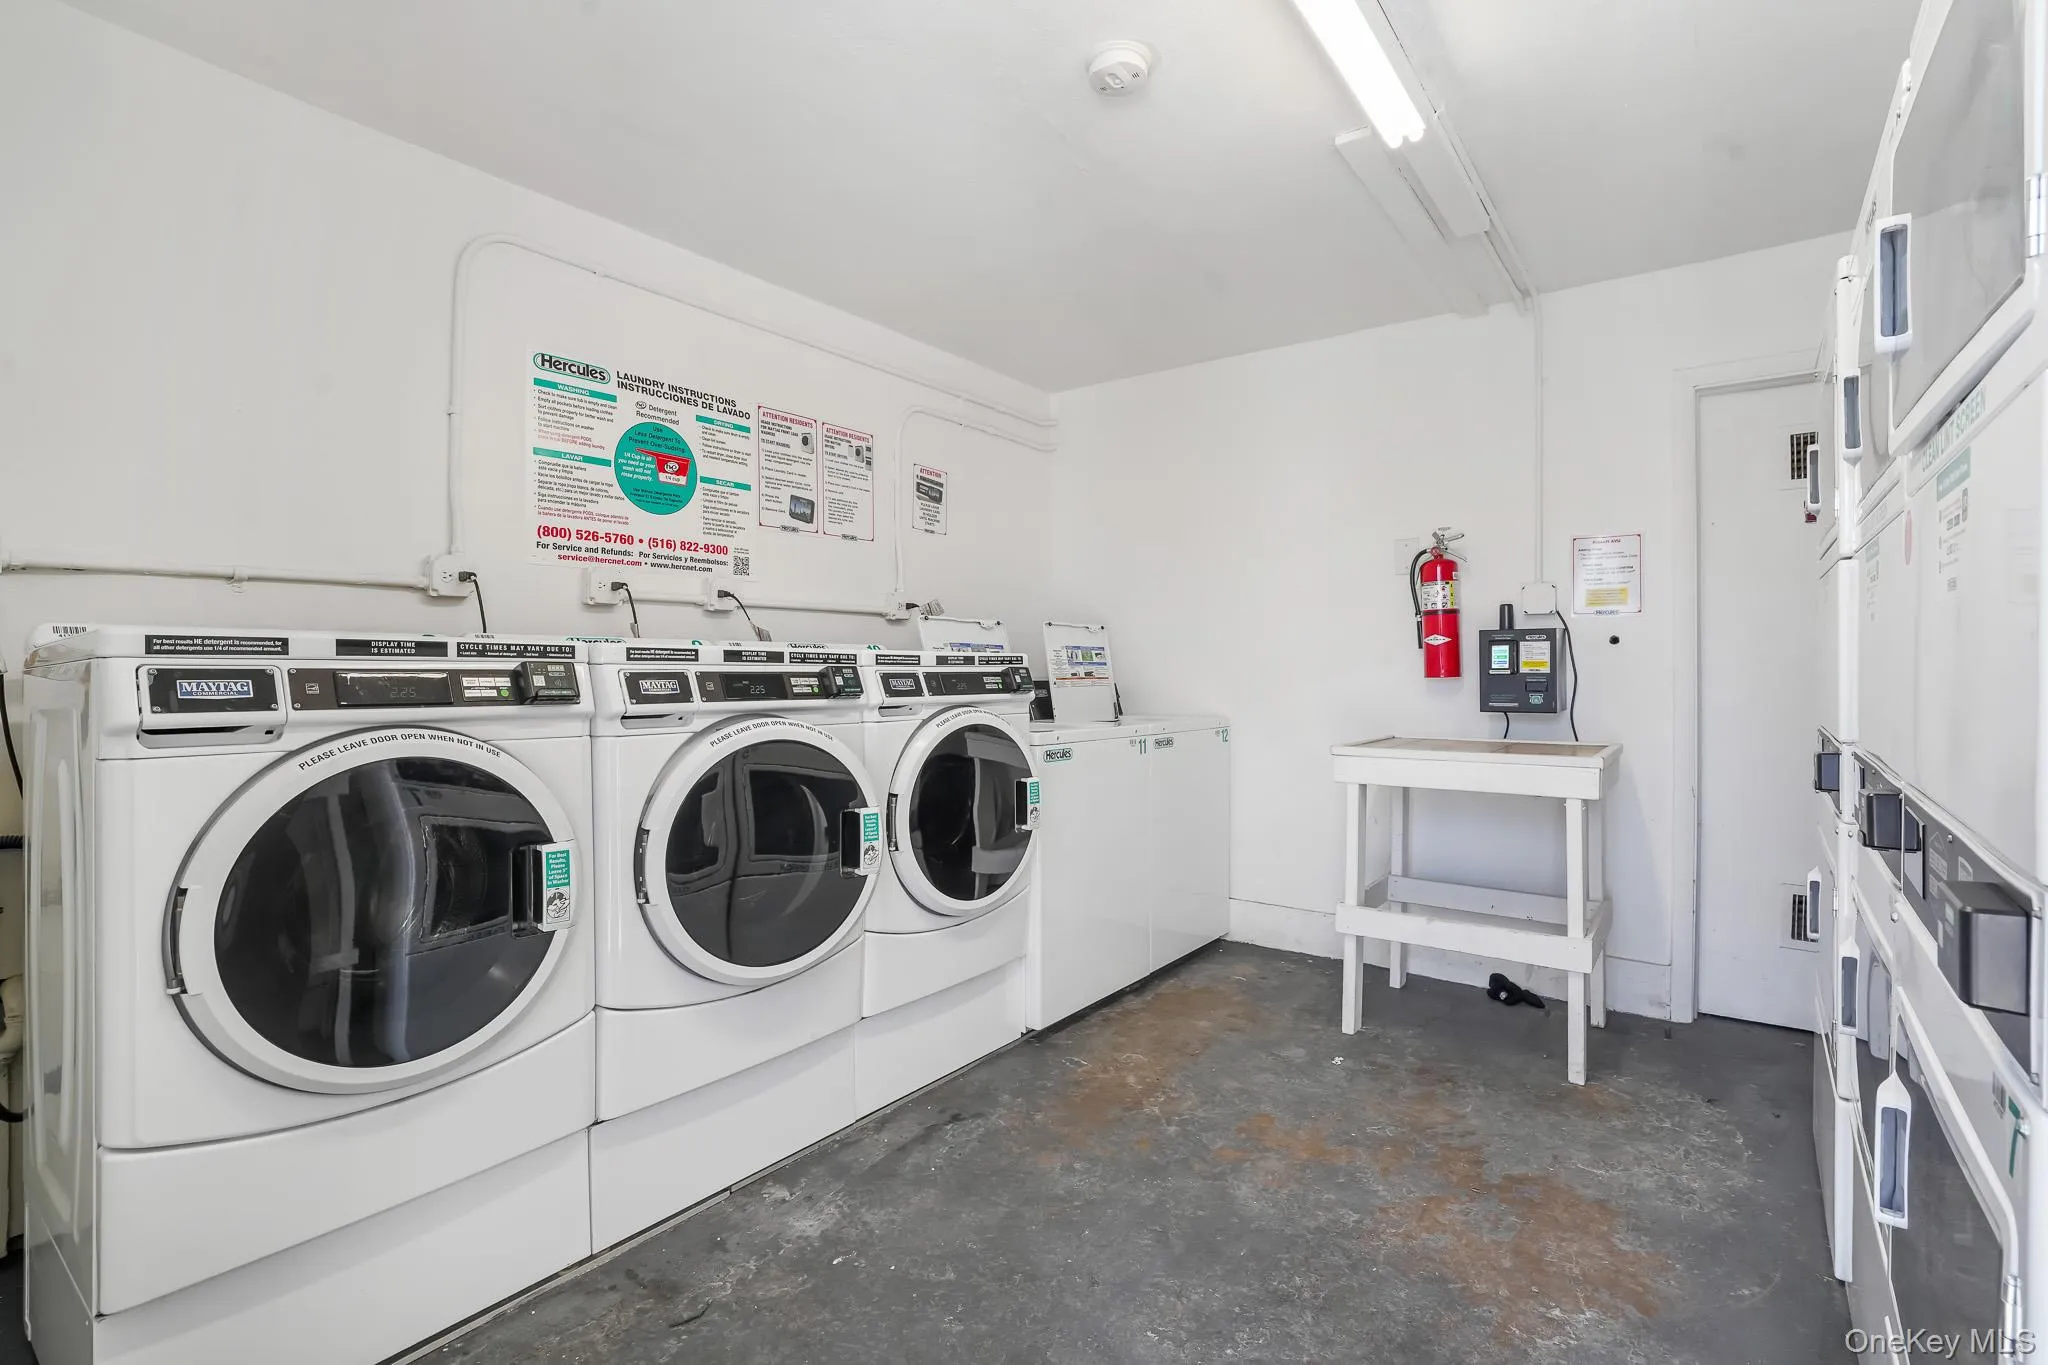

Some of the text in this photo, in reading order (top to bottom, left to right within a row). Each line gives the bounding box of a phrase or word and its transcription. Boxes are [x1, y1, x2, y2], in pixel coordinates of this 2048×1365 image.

[541, 354, 606, 381] Hercules
[558, 384, 589, 396] WASHING
[616, 370, 736, 408] LAUNDRY INSTRUCTIONS
[618, 380, 751, 420] INSTRUCCIONES DE LAVADO
[636, 410, 679, 425] Recommended
[649, 404, 677, 416] Detergent
[1956, 384, 1986, 438] SCREEN
[763, 412, 813, 428] ATTENTION RESIDENTS
[826, 428, 869, 443] ATTENTION RESIDENTS
[561, 454, 583, 462] LAVAR
[920, 468, 941, 478] ATTENTION
[537, 524, 571, 541] (800)
[576, 529, 634, 545] 526-5760
[648, 537, 676, 552] (516)
[680, 541, 728, 555] 822-9300
[552, 542, 582, 552] Service
[601, 547, 634, 556] Refunds:
[652, 553, 682, 562] Servicios
[690, 556, 728, 566] Reembolsos:
[558, 553, 713, 573] service@hercnet.com www.hercnet.com
[181, 682, 249, 692] MAYTAG
[710, 732, 732, 747] PLEASE
[733, 725, 751, 736] LEAVE
[824, 732, 833, 741] USE
[1155, 738, 1173, 747] Hercules
[1222, 729, 1229, 742] 12
[299, 750, 337, 770] PLEASE
[338, 739, 368, 754] LEAVE
[371, 734, 399, 745] DOOR
[428, 734, 454, 743] WHEN
[457, 737, 473, 747] NOT
[475, 742, 484, 750] IN
[486, 746, 500, 758] USE
[1138, 738, 1147, 754] 11
[1046, 749, 1071, 760] Hercules
